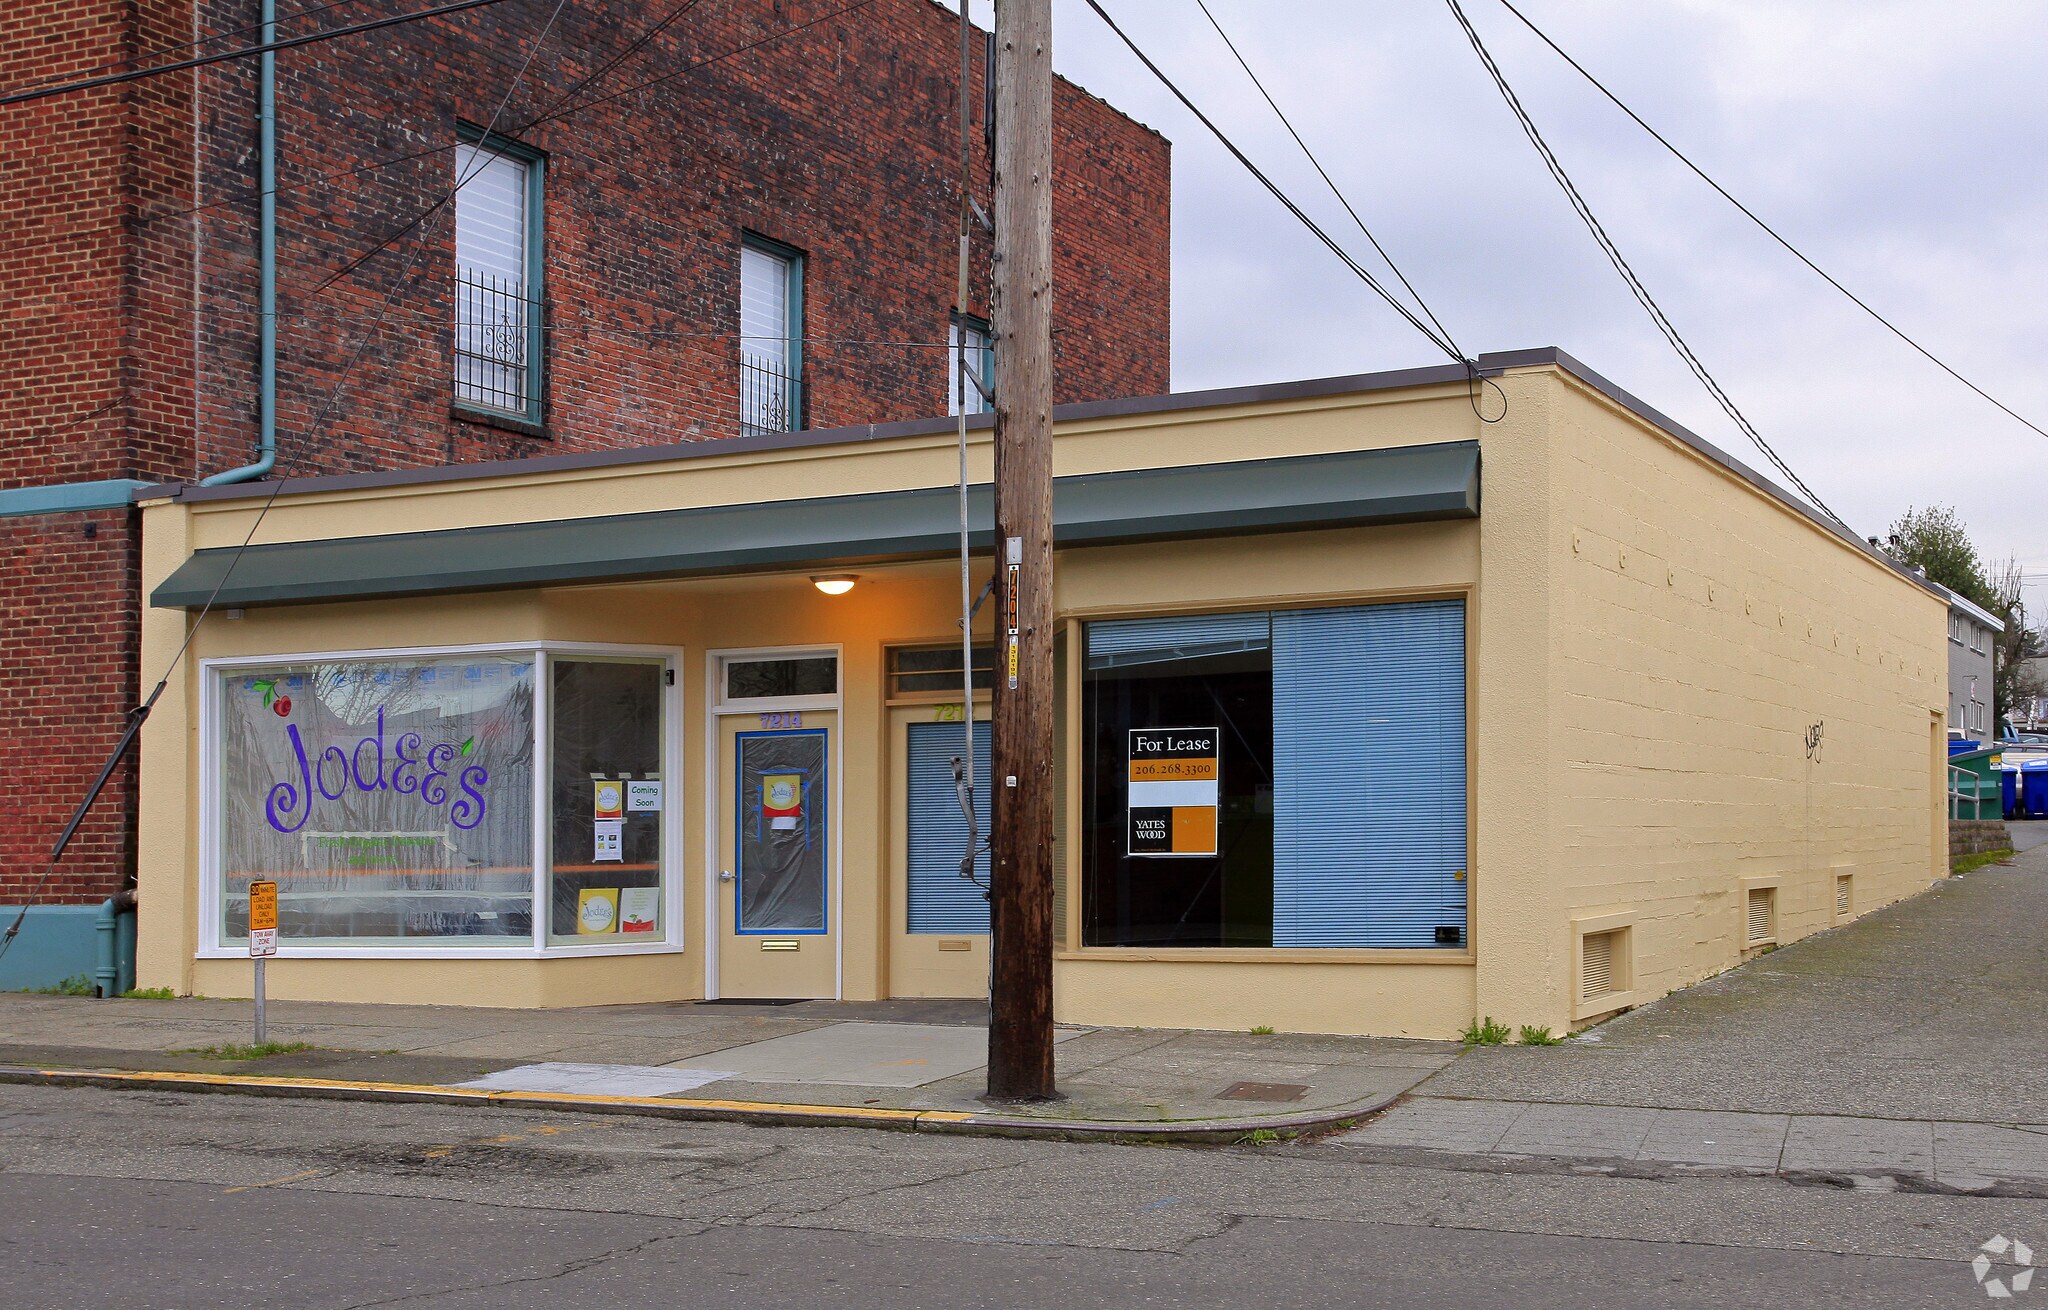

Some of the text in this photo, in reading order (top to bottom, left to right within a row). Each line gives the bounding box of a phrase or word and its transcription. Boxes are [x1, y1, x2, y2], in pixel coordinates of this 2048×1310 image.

[933, 704, 974, 721] 721
[759, 713, 802, 729] 7214
[1136, 736, 1211, 752] For Lease
[1135, 763, 1211, 776] 206.268.3300
[631, 786, 659, 796] Coming
[635, 799, 655, 807] Soon
[1135, 820, 1166, 829] YATES
[1135, 830, 1166, 840] WOOD
